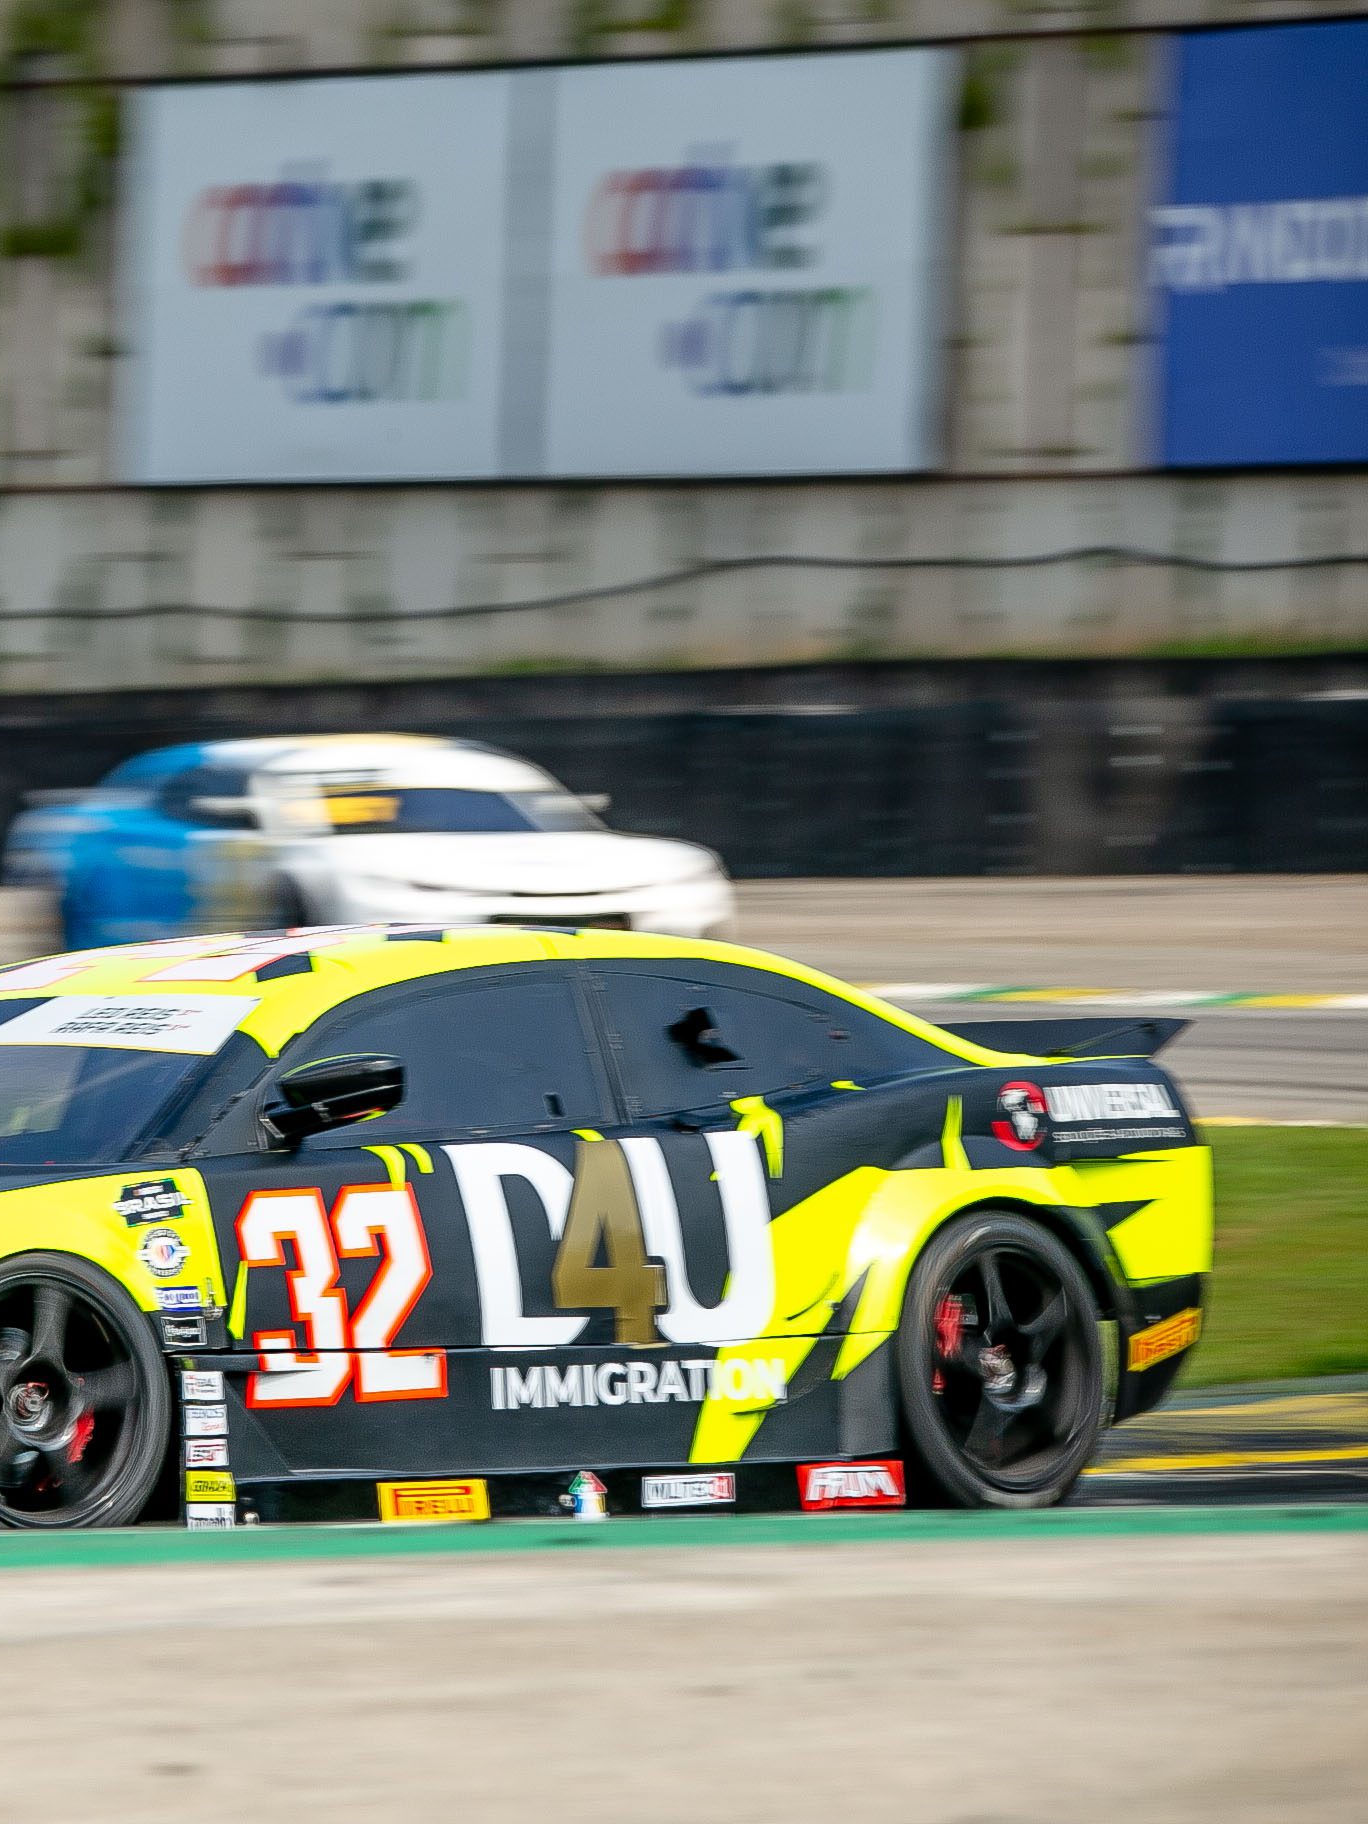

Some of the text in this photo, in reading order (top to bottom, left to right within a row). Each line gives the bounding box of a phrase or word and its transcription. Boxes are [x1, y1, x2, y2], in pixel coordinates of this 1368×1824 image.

[113, 1191, 193, 1217] BRASIL
[233, 1181, 449, 1409] 32
[489, 1359, 787, 1410] IMMIGRATION
